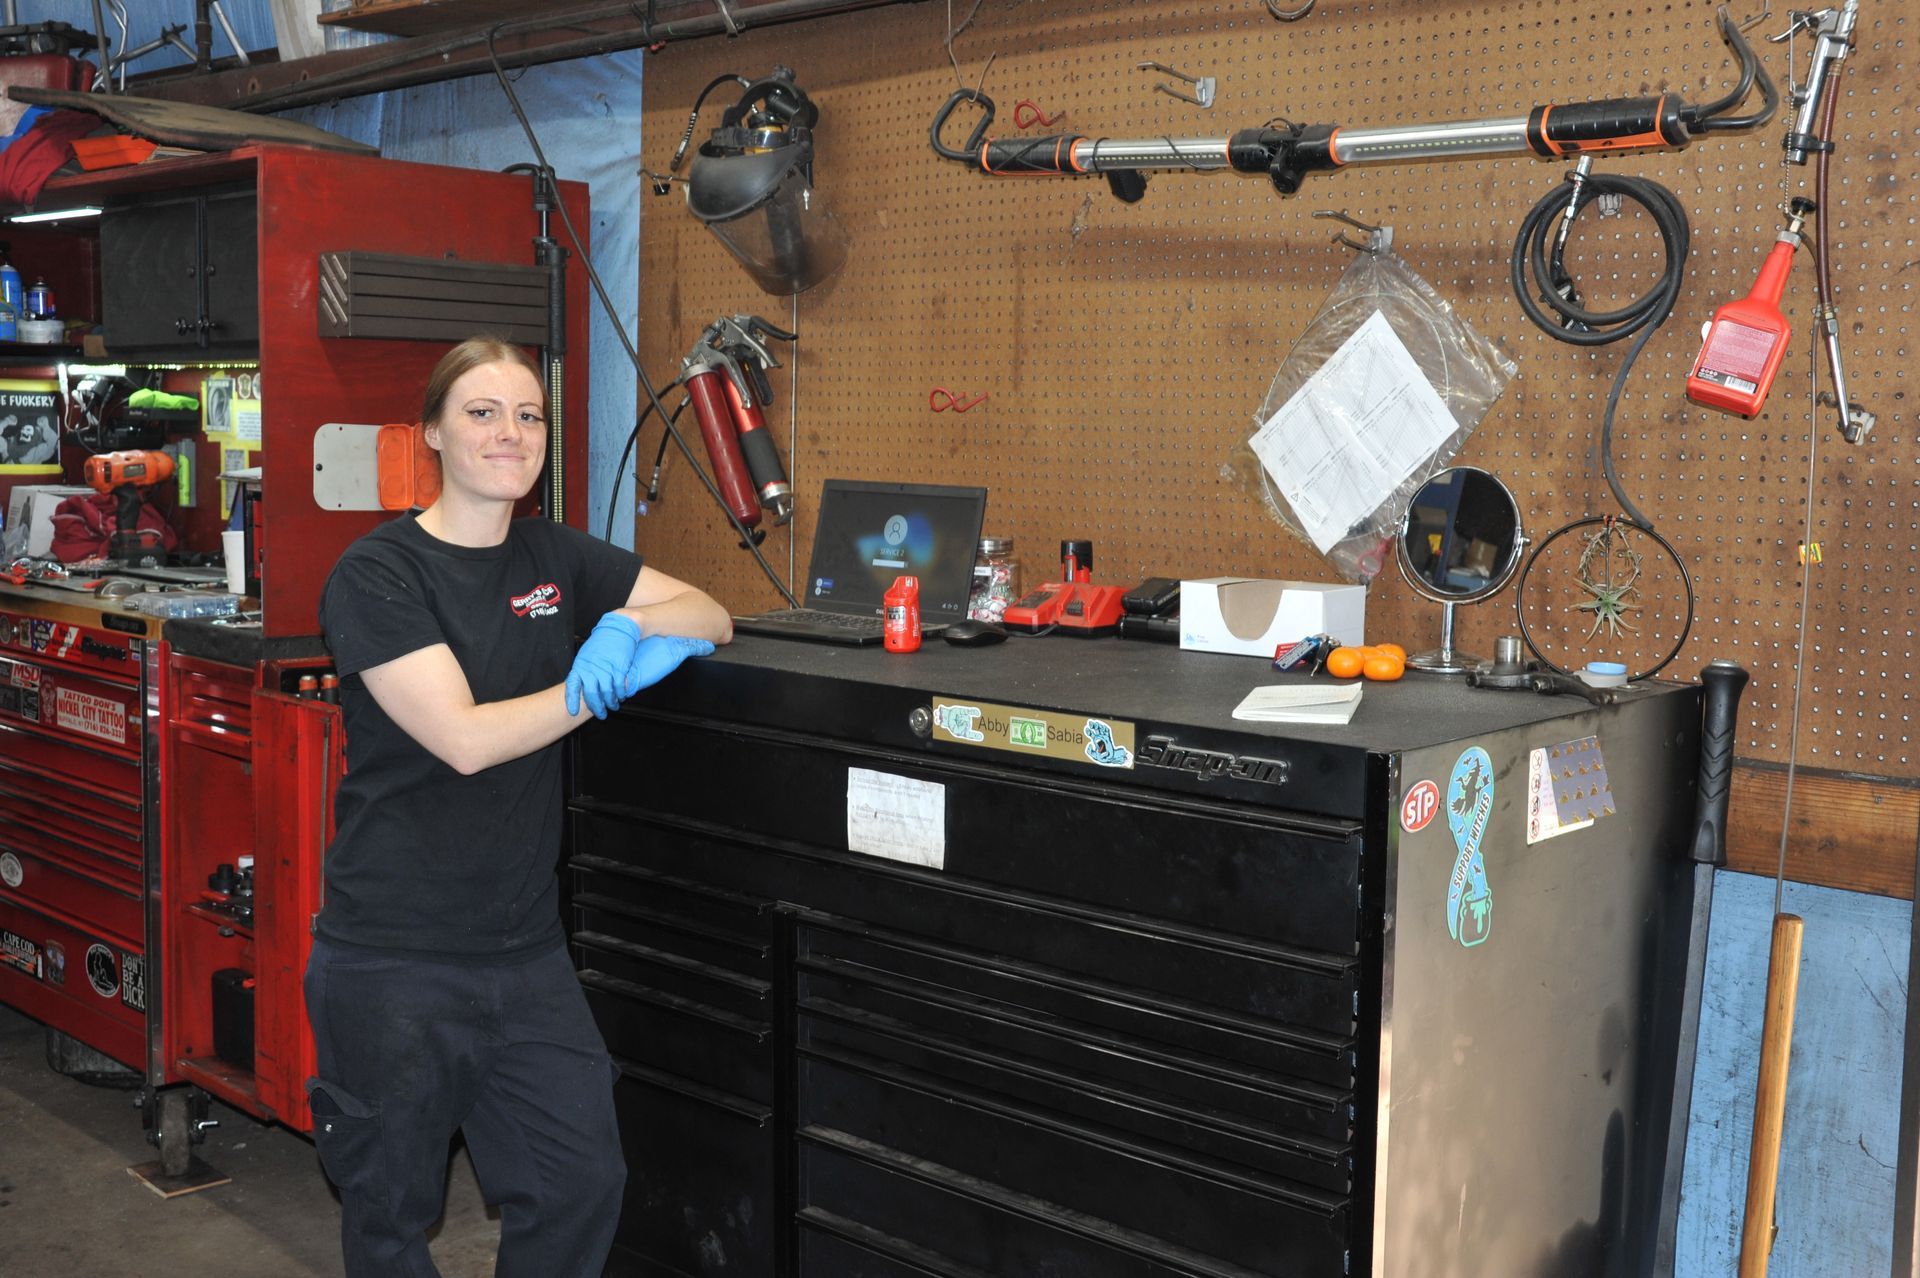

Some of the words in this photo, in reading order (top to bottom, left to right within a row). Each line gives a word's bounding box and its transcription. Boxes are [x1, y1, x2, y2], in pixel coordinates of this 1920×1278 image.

[9, 394, 56, 408] FUCKERY
[14, 664, 40, 681] MSD
[58, 699, 81, 718] NICKEL
[82, 704, 97, 722] CITY
[97, 709, 124, 729] TATTOO
[64, 691, 92, 705] TATTOO
[93, 698, 116, 711] DON'S
[978, 716, 1009, 737] Abby
[1046, 726, 1083, 745] Sabia
[1135, 734, 1290, 786] Snap-on
[1406, 785, 1435, 827] STP
[1453, 839, 1475, 889] SUPPORT
[1469, 793, 1490, 842] WITCHES
[3, 931, 20, 949] CAPE
[20, 939, 35, 955] COD
[122, 969, 134, 985] BE
[137, 976, 144, 990] A
[122, 982, 145, 1009] DICK
